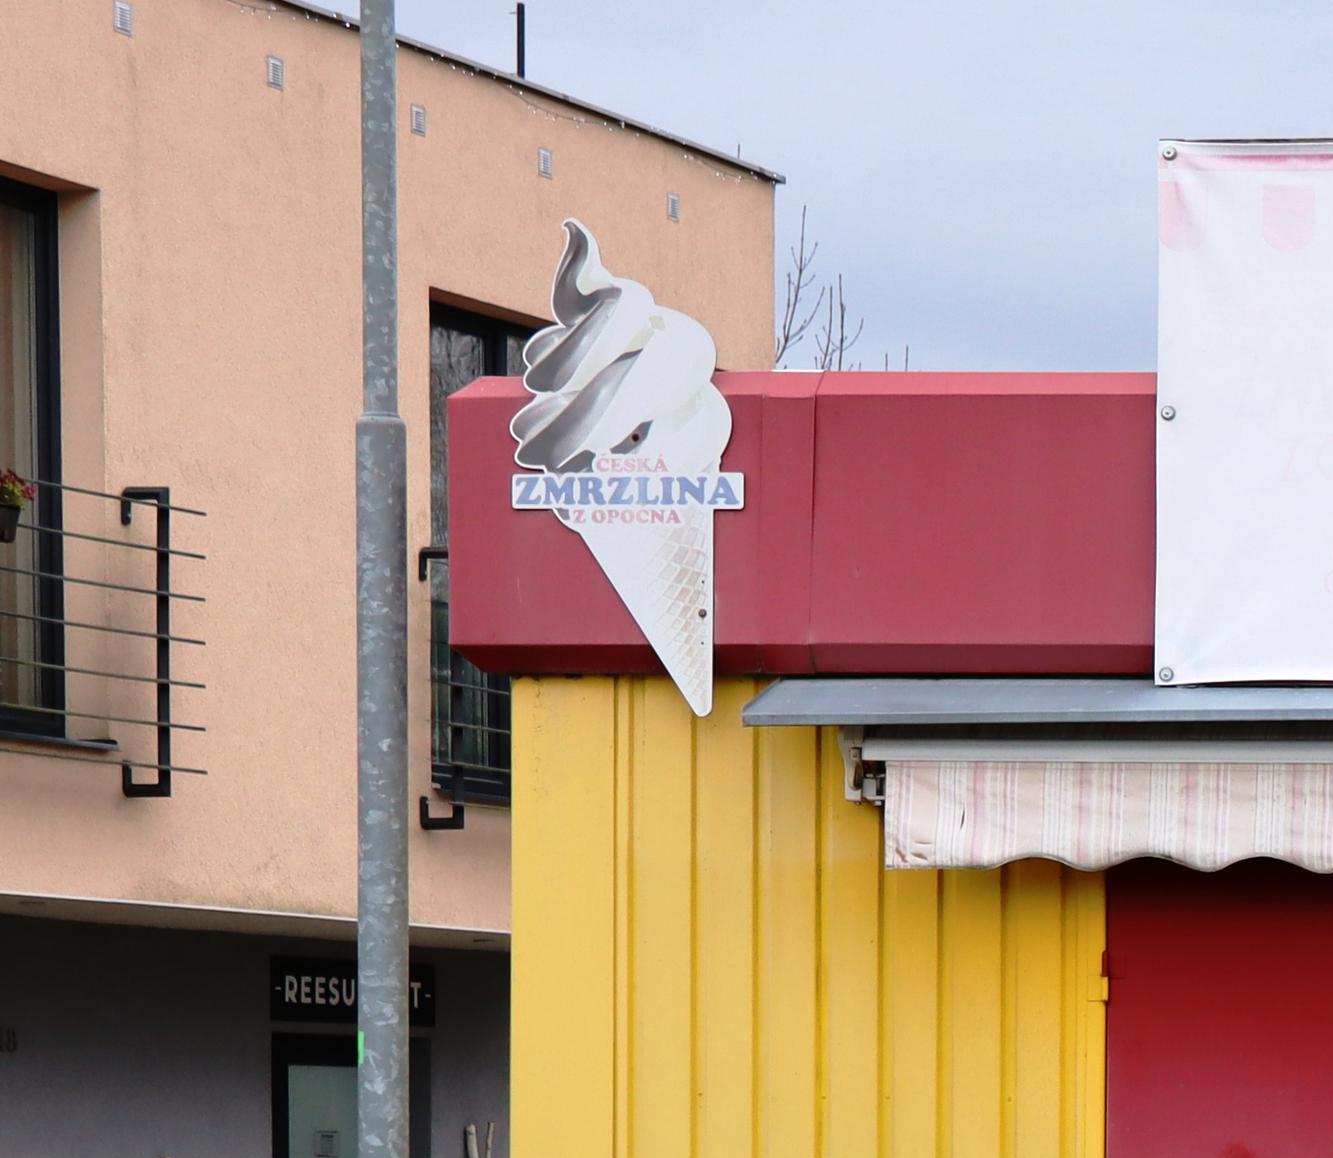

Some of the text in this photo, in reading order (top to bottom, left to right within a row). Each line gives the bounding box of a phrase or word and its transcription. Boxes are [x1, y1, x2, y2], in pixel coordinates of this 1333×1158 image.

[596, 454, 668, 473] ČESKÁ
[515, 476, 739, 506] ZMRZLINA
[573, 509, 587, 523] Z
